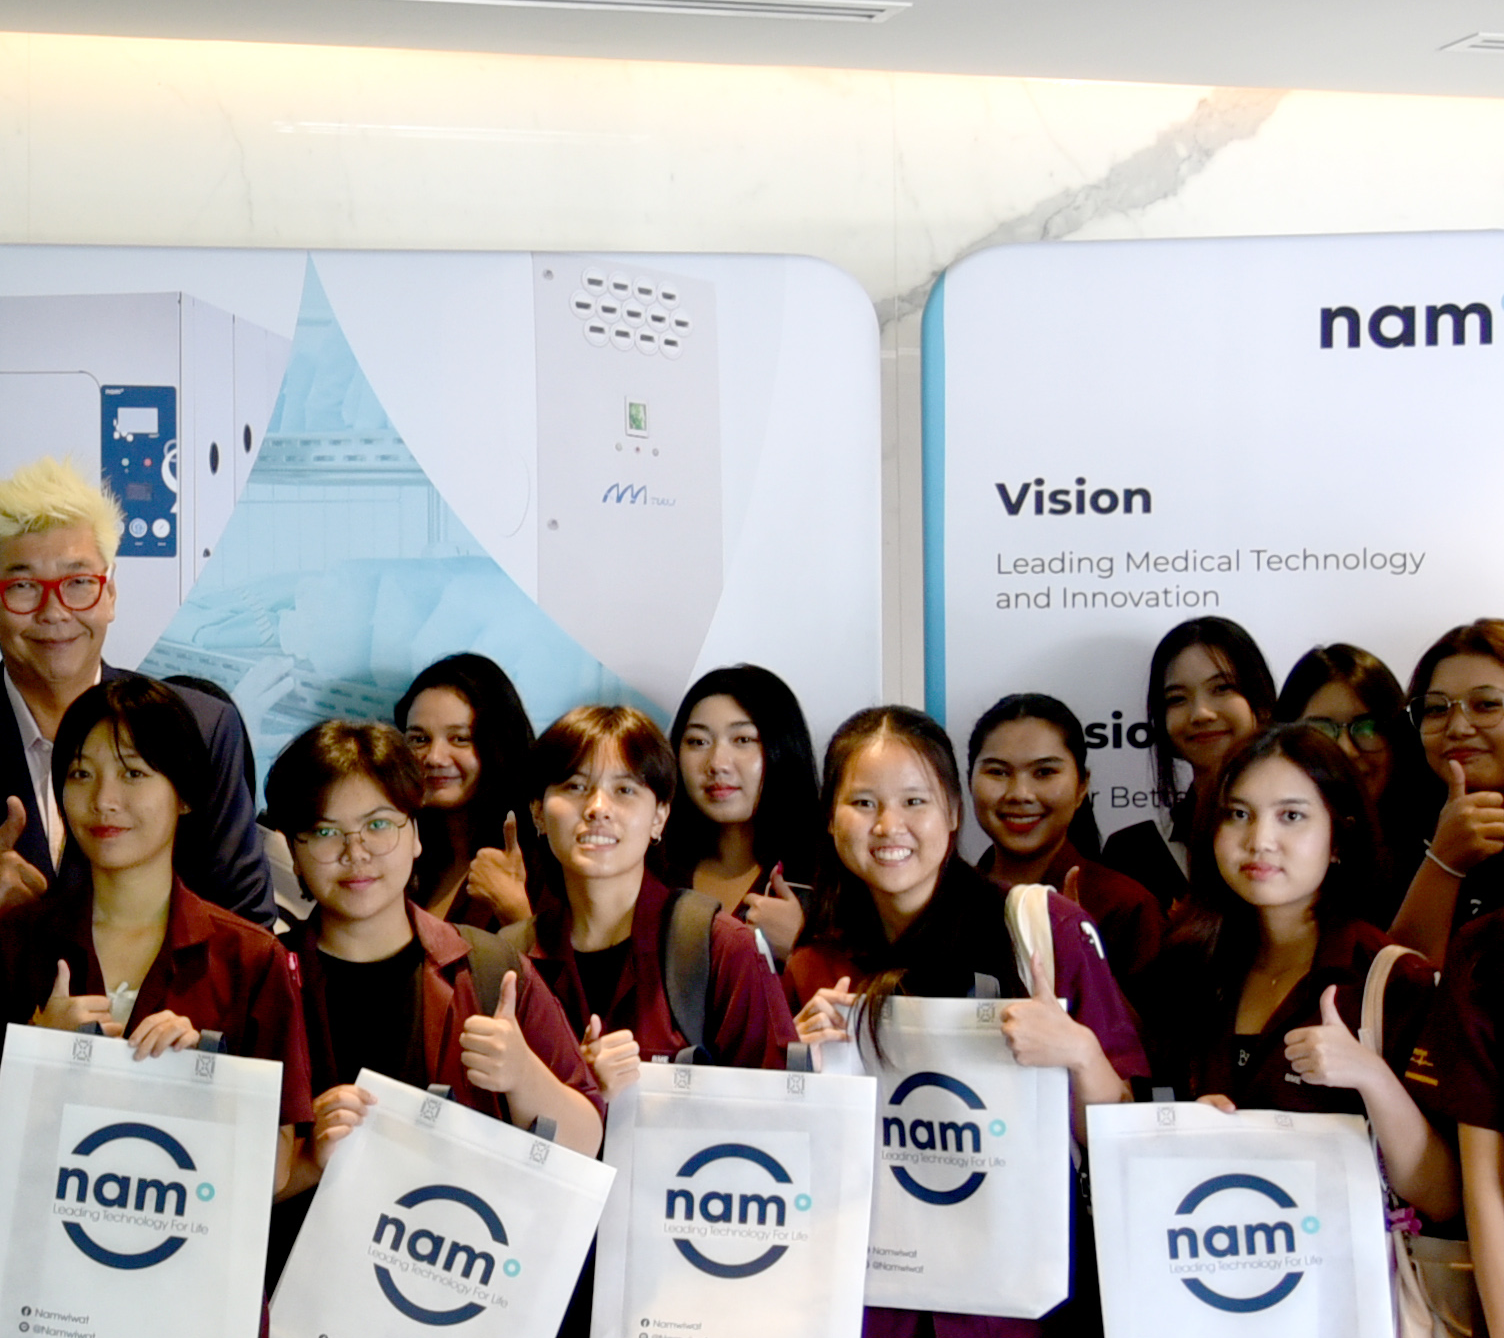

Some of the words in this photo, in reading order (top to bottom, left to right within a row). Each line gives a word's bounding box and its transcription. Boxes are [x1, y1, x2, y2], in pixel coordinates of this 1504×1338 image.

[995, 477, 1152, 517] Vision
[996, 549, 1115, 580] Leading
[1126, 548, 1241, 573] Medical
[1250, 547, 1426, 577] Technology
[996, 584, 1051, 610] and
[1060, 583, 1220, 609] Innovation
[53, 1202, 100, 1222] Leading
[102, 1209, 168, 1231] Technology
[170, 1219, 188, 1232] For
[190, 1222, 209, 1235] Life
[663, 1223, 708, 1236] Leading
[709, 1225, 771, 1240] Technology
[772, 1229, 789, 1240] For
[791, 1231, 808, 1242] Life
[367, 1245, 410, 1273] Leading
[411, 1262, 472, 1297] Technology
[472, 1286, 490, 1302] For
[491, 1292, 508, 1309] Life
